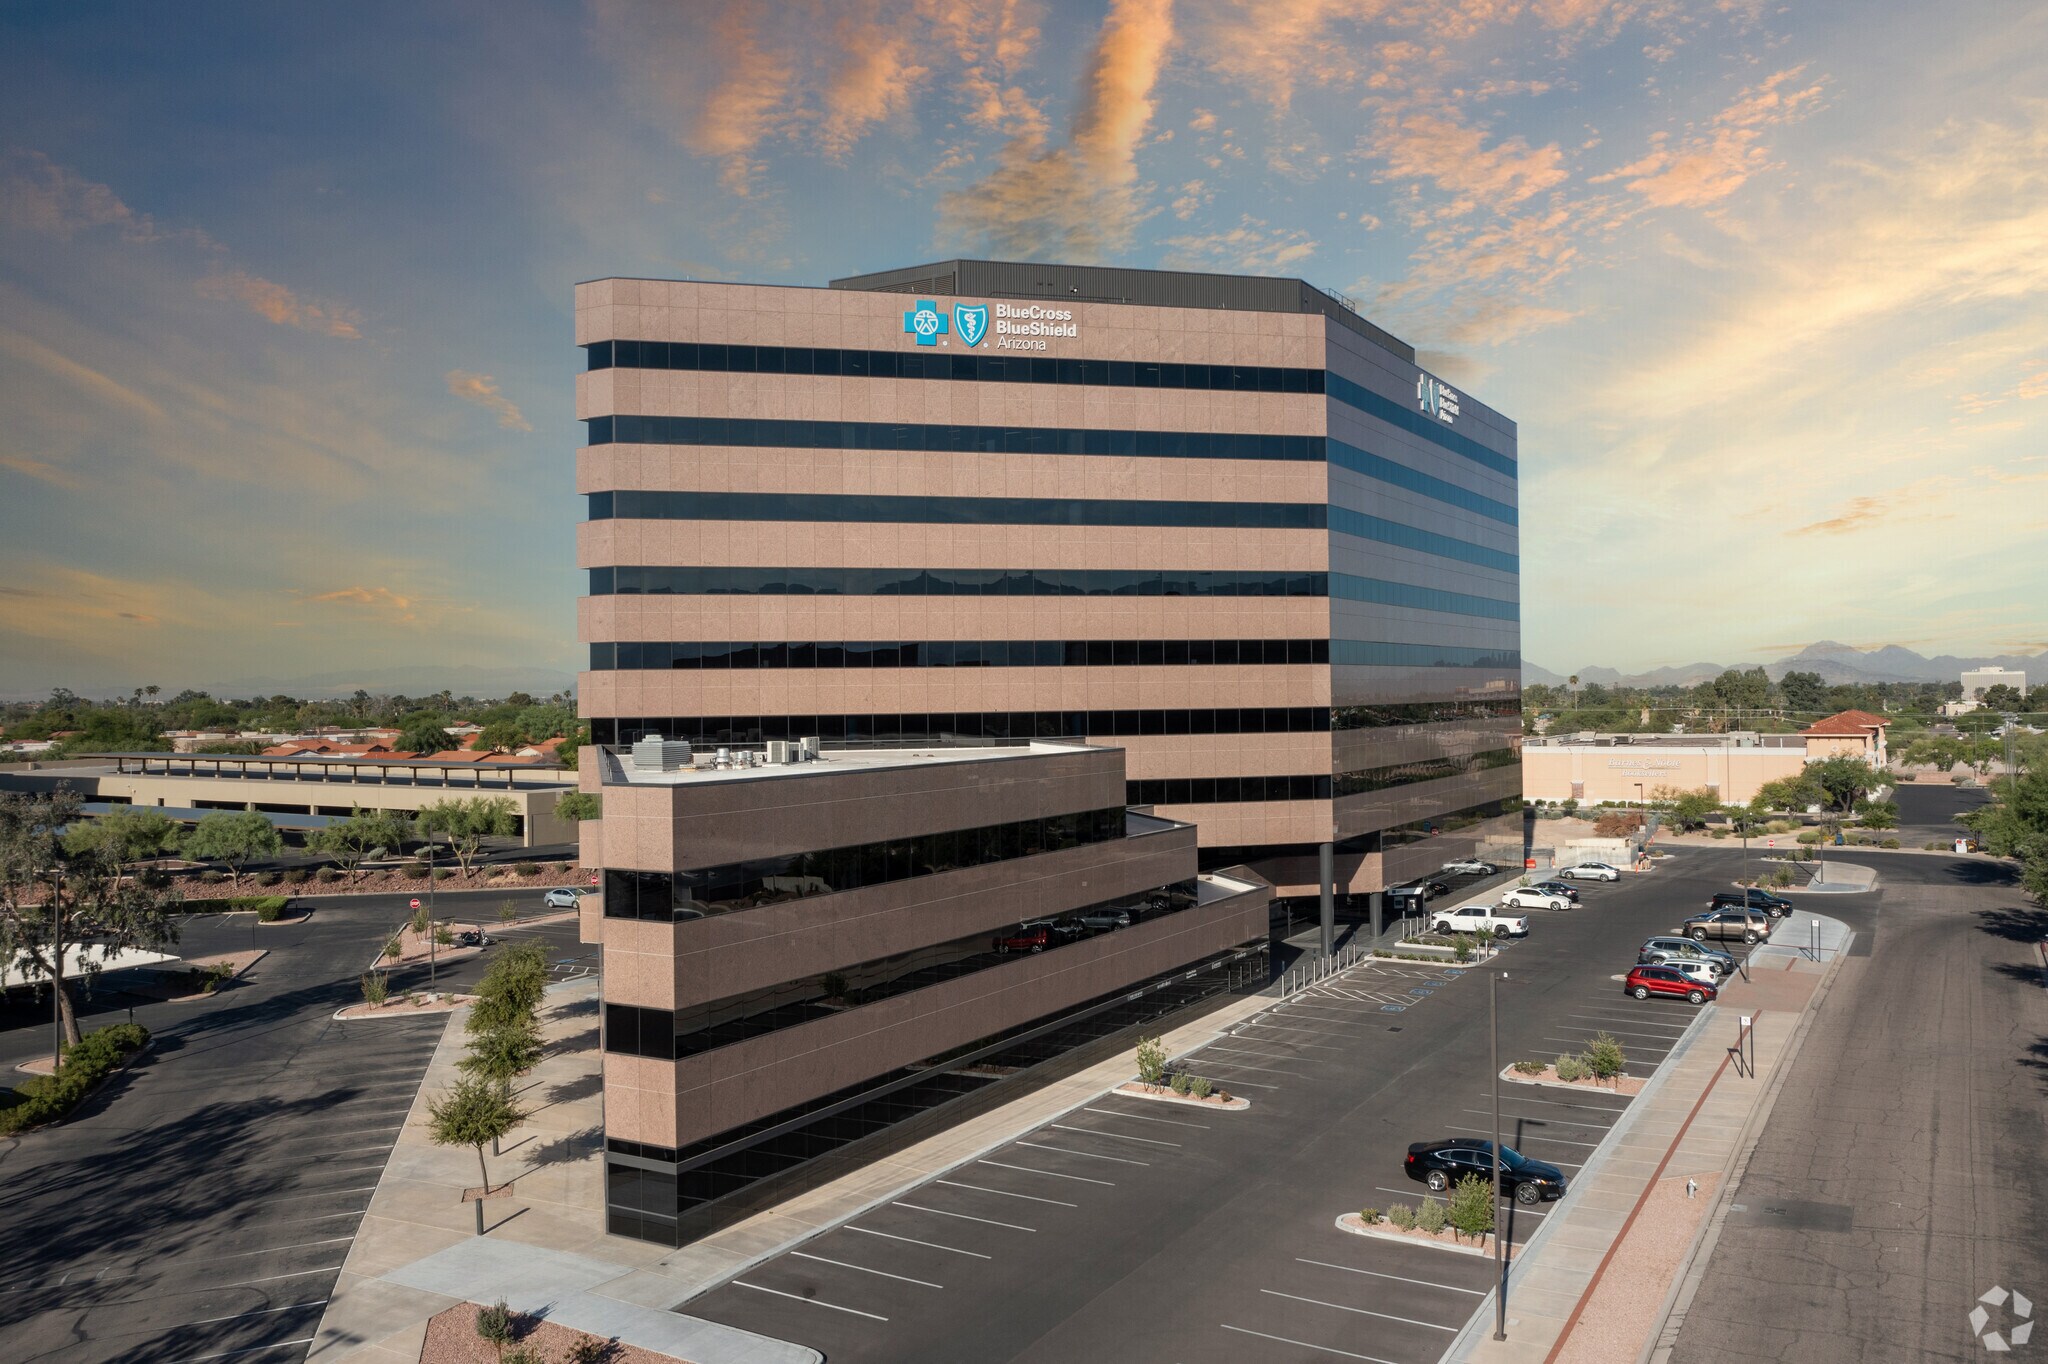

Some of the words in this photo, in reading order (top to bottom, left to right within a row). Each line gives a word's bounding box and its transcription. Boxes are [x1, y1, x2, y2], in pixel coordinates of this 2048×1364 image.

[996, 303, 1072, 321] BlueCross
[996, 320, 1077, 337] BlueShield
[997, 336, 1046, 351] Arizona
[1608, 757, 1641, 767] Barnes
[1653, 758, 1681, 767] Noble
[1622, 769, 1668, 777] Booksellers
